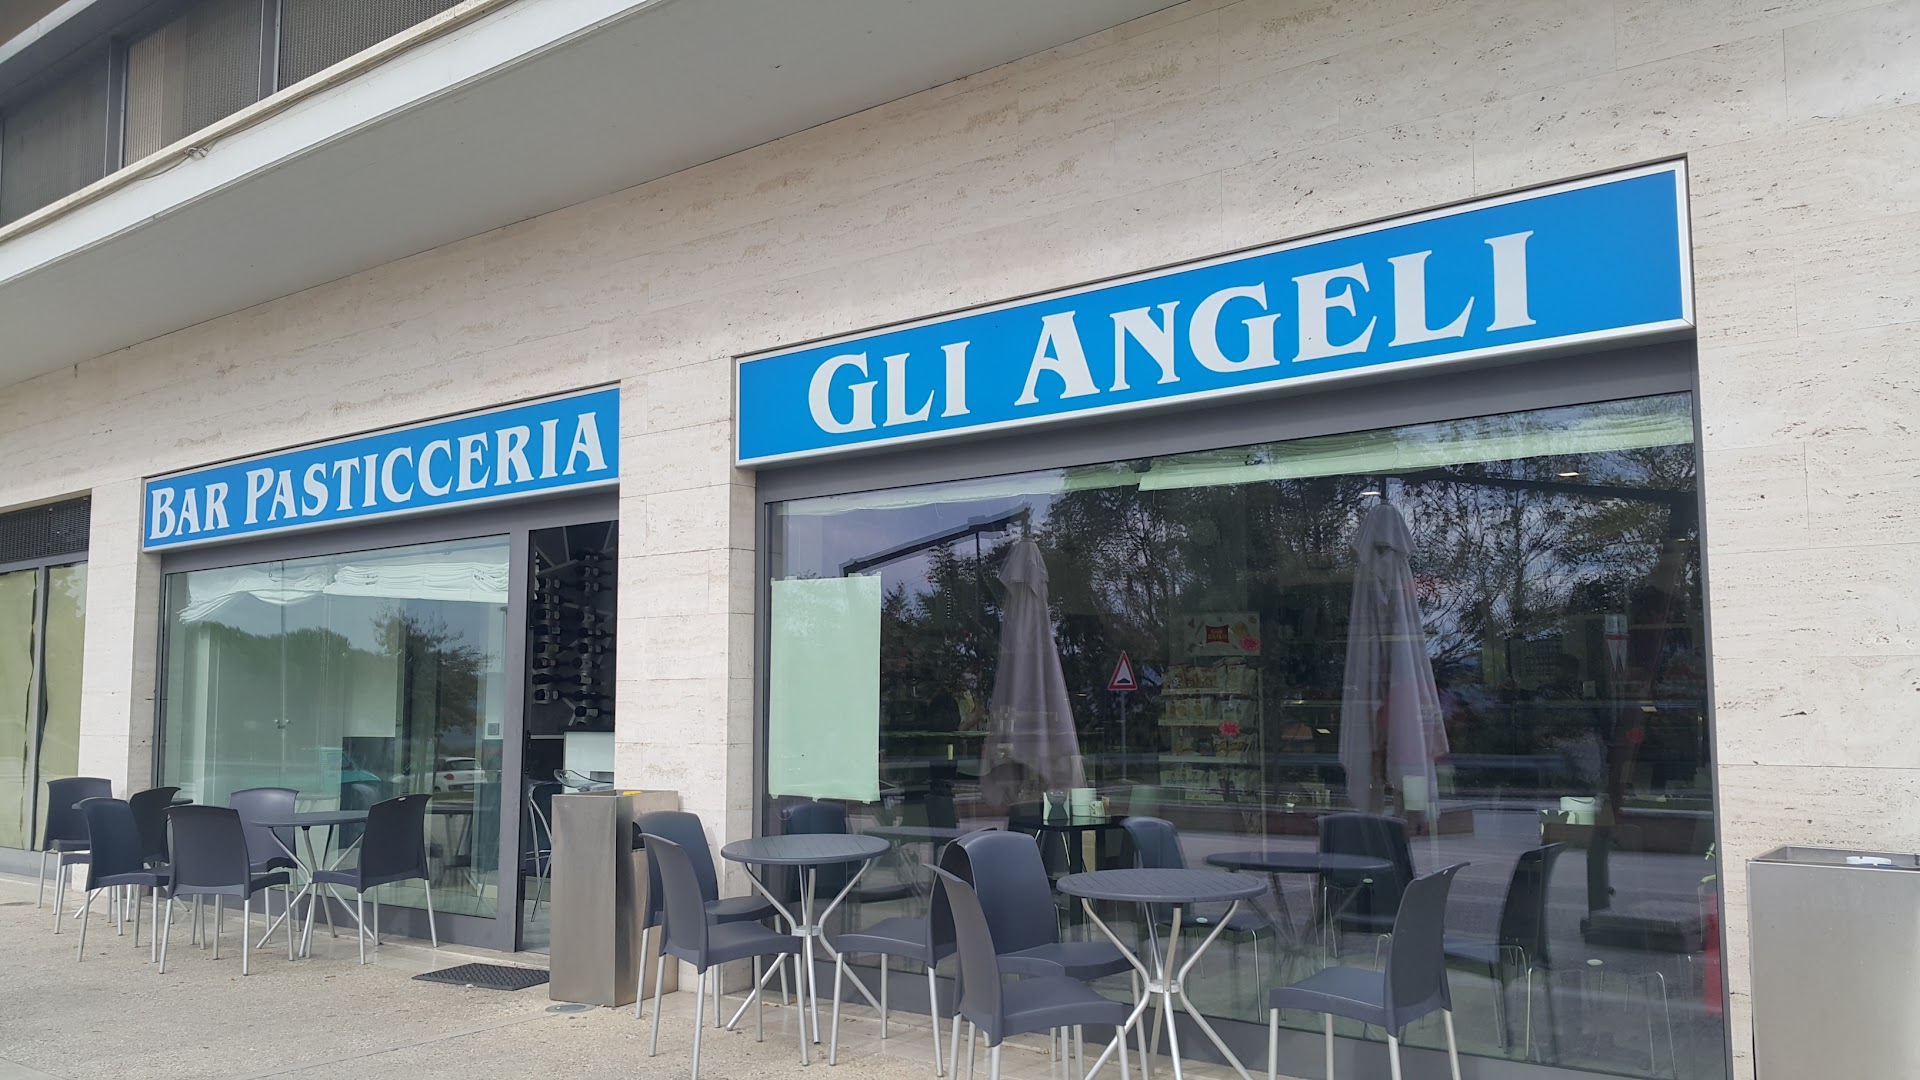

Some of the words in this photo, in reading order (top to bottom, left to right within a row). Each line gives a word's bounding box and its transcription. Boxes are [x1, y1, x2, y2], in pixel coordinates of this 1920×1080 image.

[808, 340, 971, 434] GLI
[1014, 230, 1537, 406] ANGELI
[149, 482, 230, 540] BAR
[243, 411, 608, 525] PASTICCERIA
